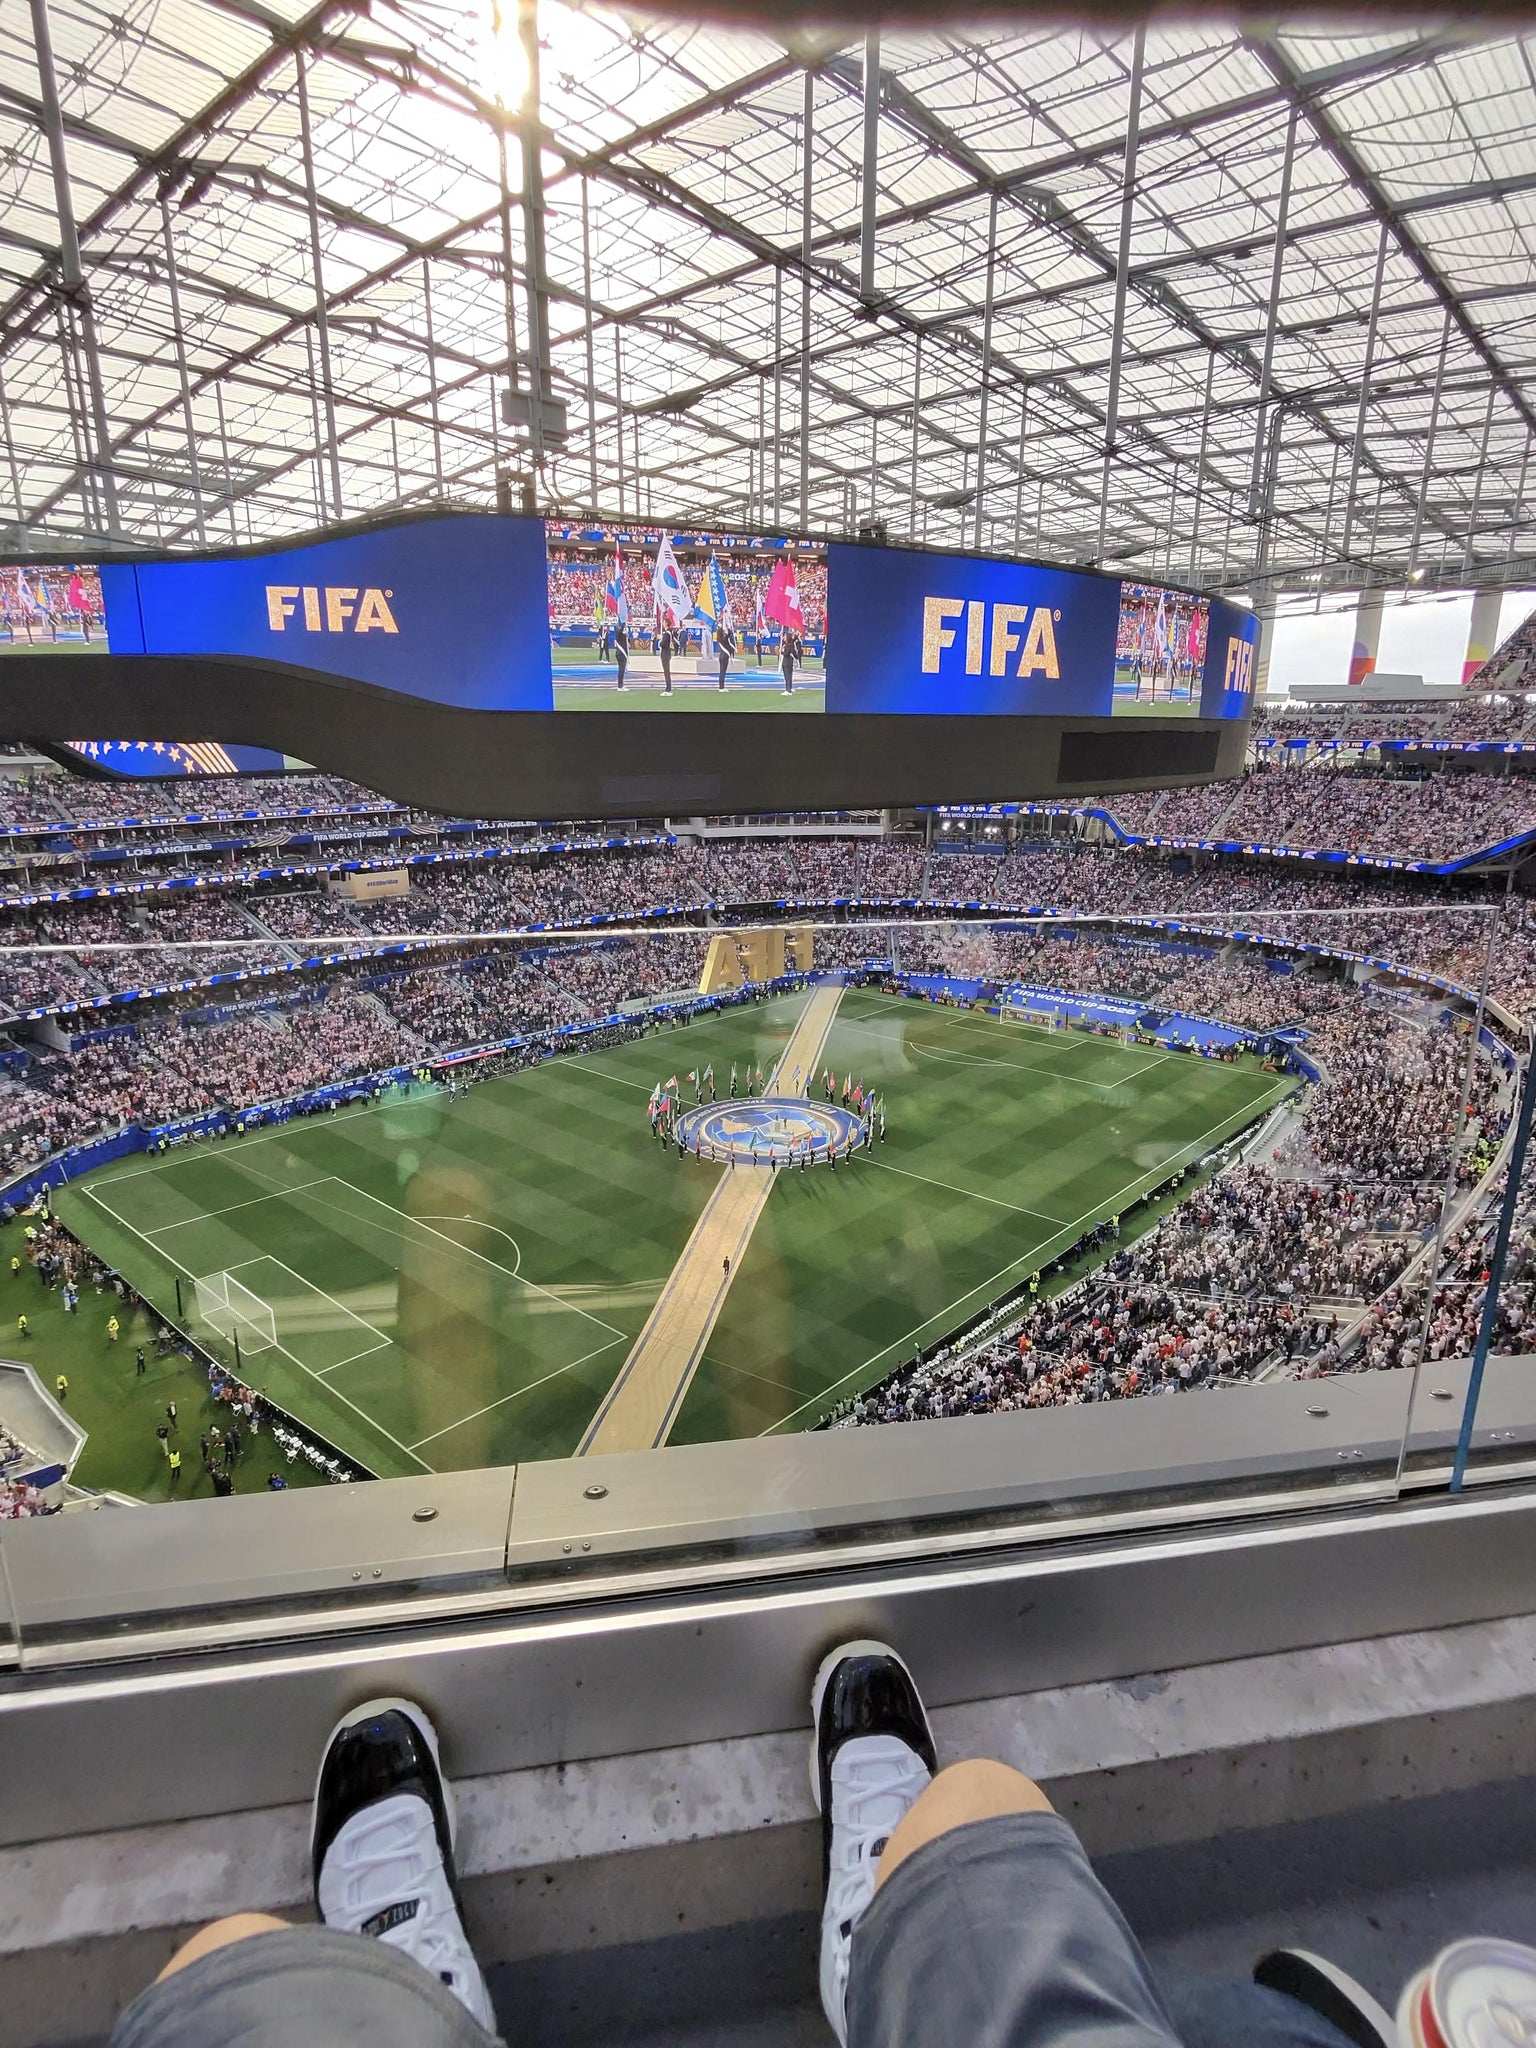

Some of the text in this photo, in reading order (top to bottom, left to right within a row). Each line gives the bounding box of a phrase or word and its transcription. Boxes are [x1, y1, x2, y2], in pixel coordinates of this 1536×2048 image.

[619, 534, 658, 543] FIFA FIFA
[265, 585, 400, 634] FIFA
[922, 596, 1062, 679] FIFA
[1224, 636, 1254, 694] FIFA
[313, 830, 389, 842] FIFA WORLD CUP 2026
[126, 843, 212, 857] LOS ANGELES
[222, 1004, 238, 1013] FIFA
[263, 996, 278, 1005] CUP
[1012, 988, 1035, 998] FIFA
[1036, 993, 1076, 1005] WORLD
[1075, 999, 1097, 1009] CUP
[1096, 1003, 1138, 1016] 2026
[1107, 1030, 1150, 1045] FIFA FIFA
[1207, 1050, 1221, 1060] FIFA
